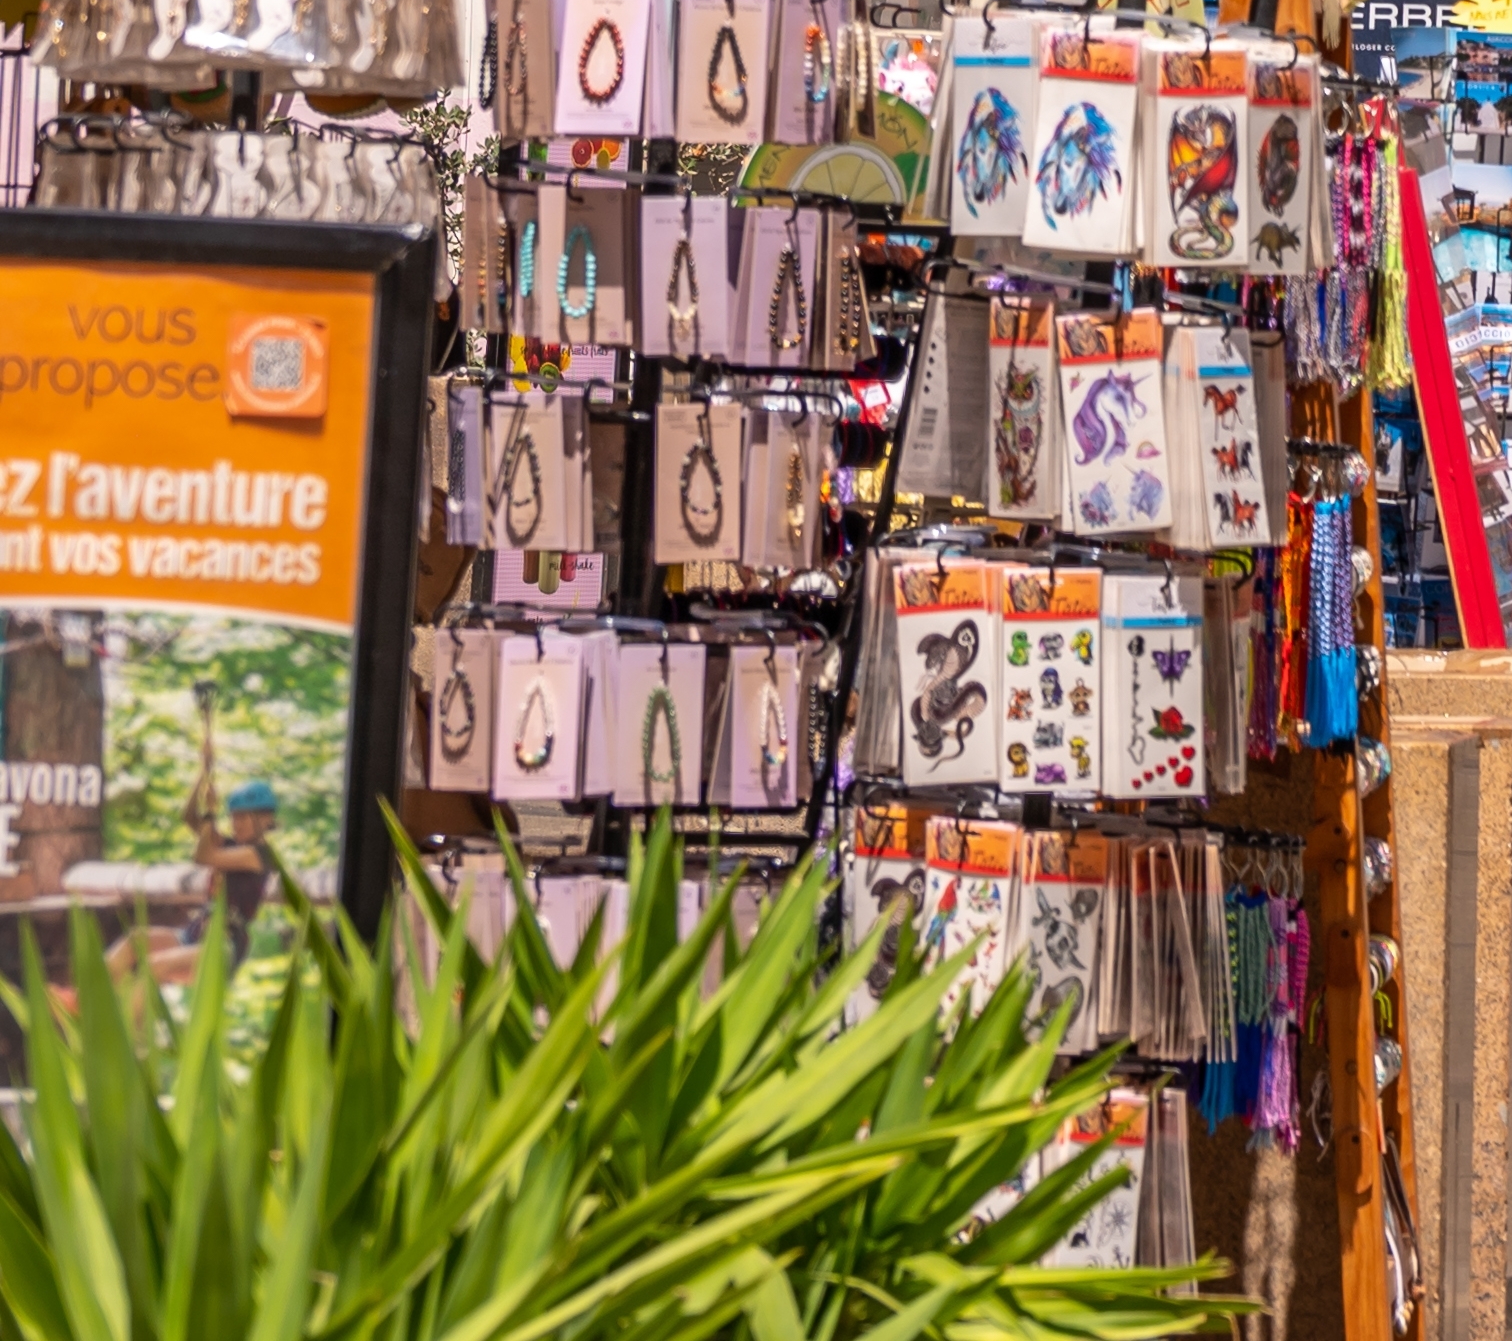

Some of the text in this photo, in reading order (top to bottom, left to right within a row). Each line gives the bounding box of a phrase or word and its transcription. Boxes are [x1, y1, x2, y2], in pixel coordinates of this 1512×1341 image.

[67, 303, 198, 346] vous
[47, 449, 329, 531] l'aventure
[51, 531, 122, 577] vos
[128, 534, 322, 586] vacances
